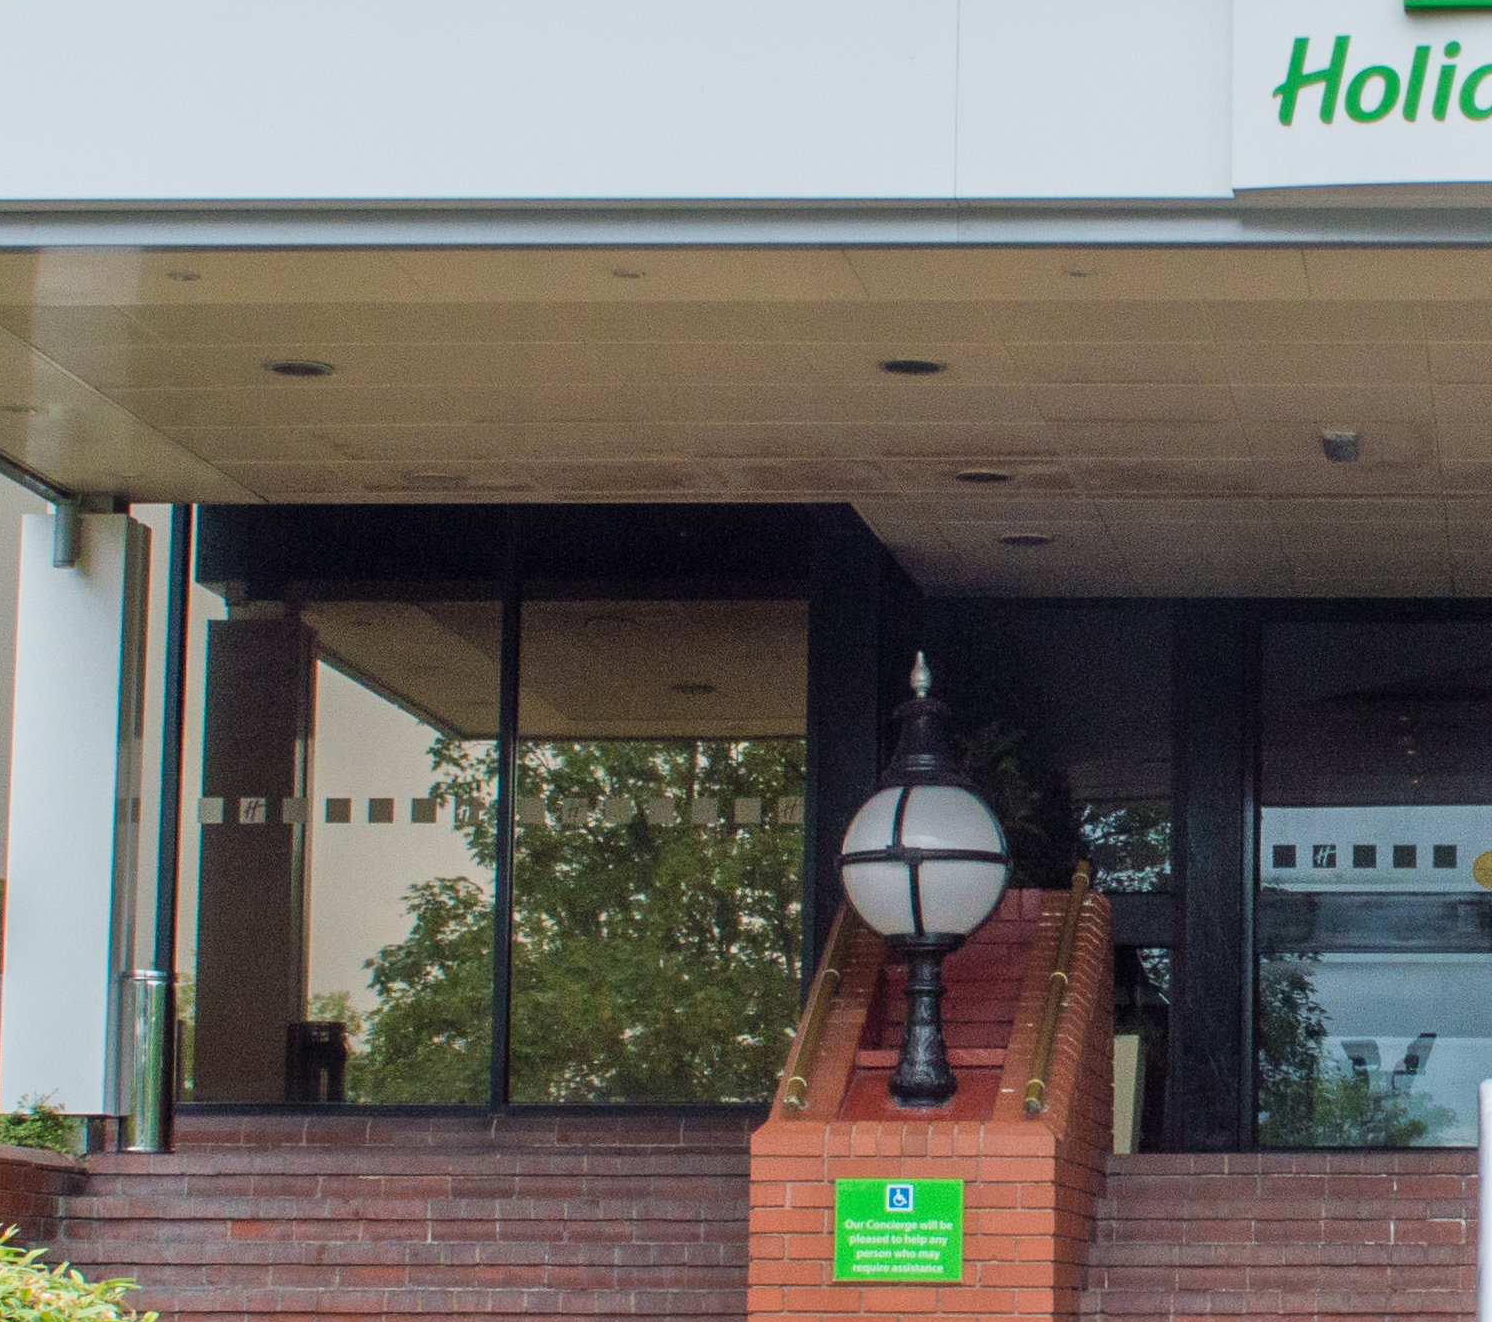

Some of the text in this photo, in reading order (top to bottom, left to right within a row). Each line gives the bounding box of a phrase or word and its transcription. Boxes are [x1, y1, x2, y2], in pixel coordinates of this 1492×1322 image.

[845, 1219, 954, 1232] Our Concierge will be
[849, 1234, 948, 1246] pleased to help any
[857, 1248, 940, 1260] person who may
[853, 1263, 944, 1274] require assistance
